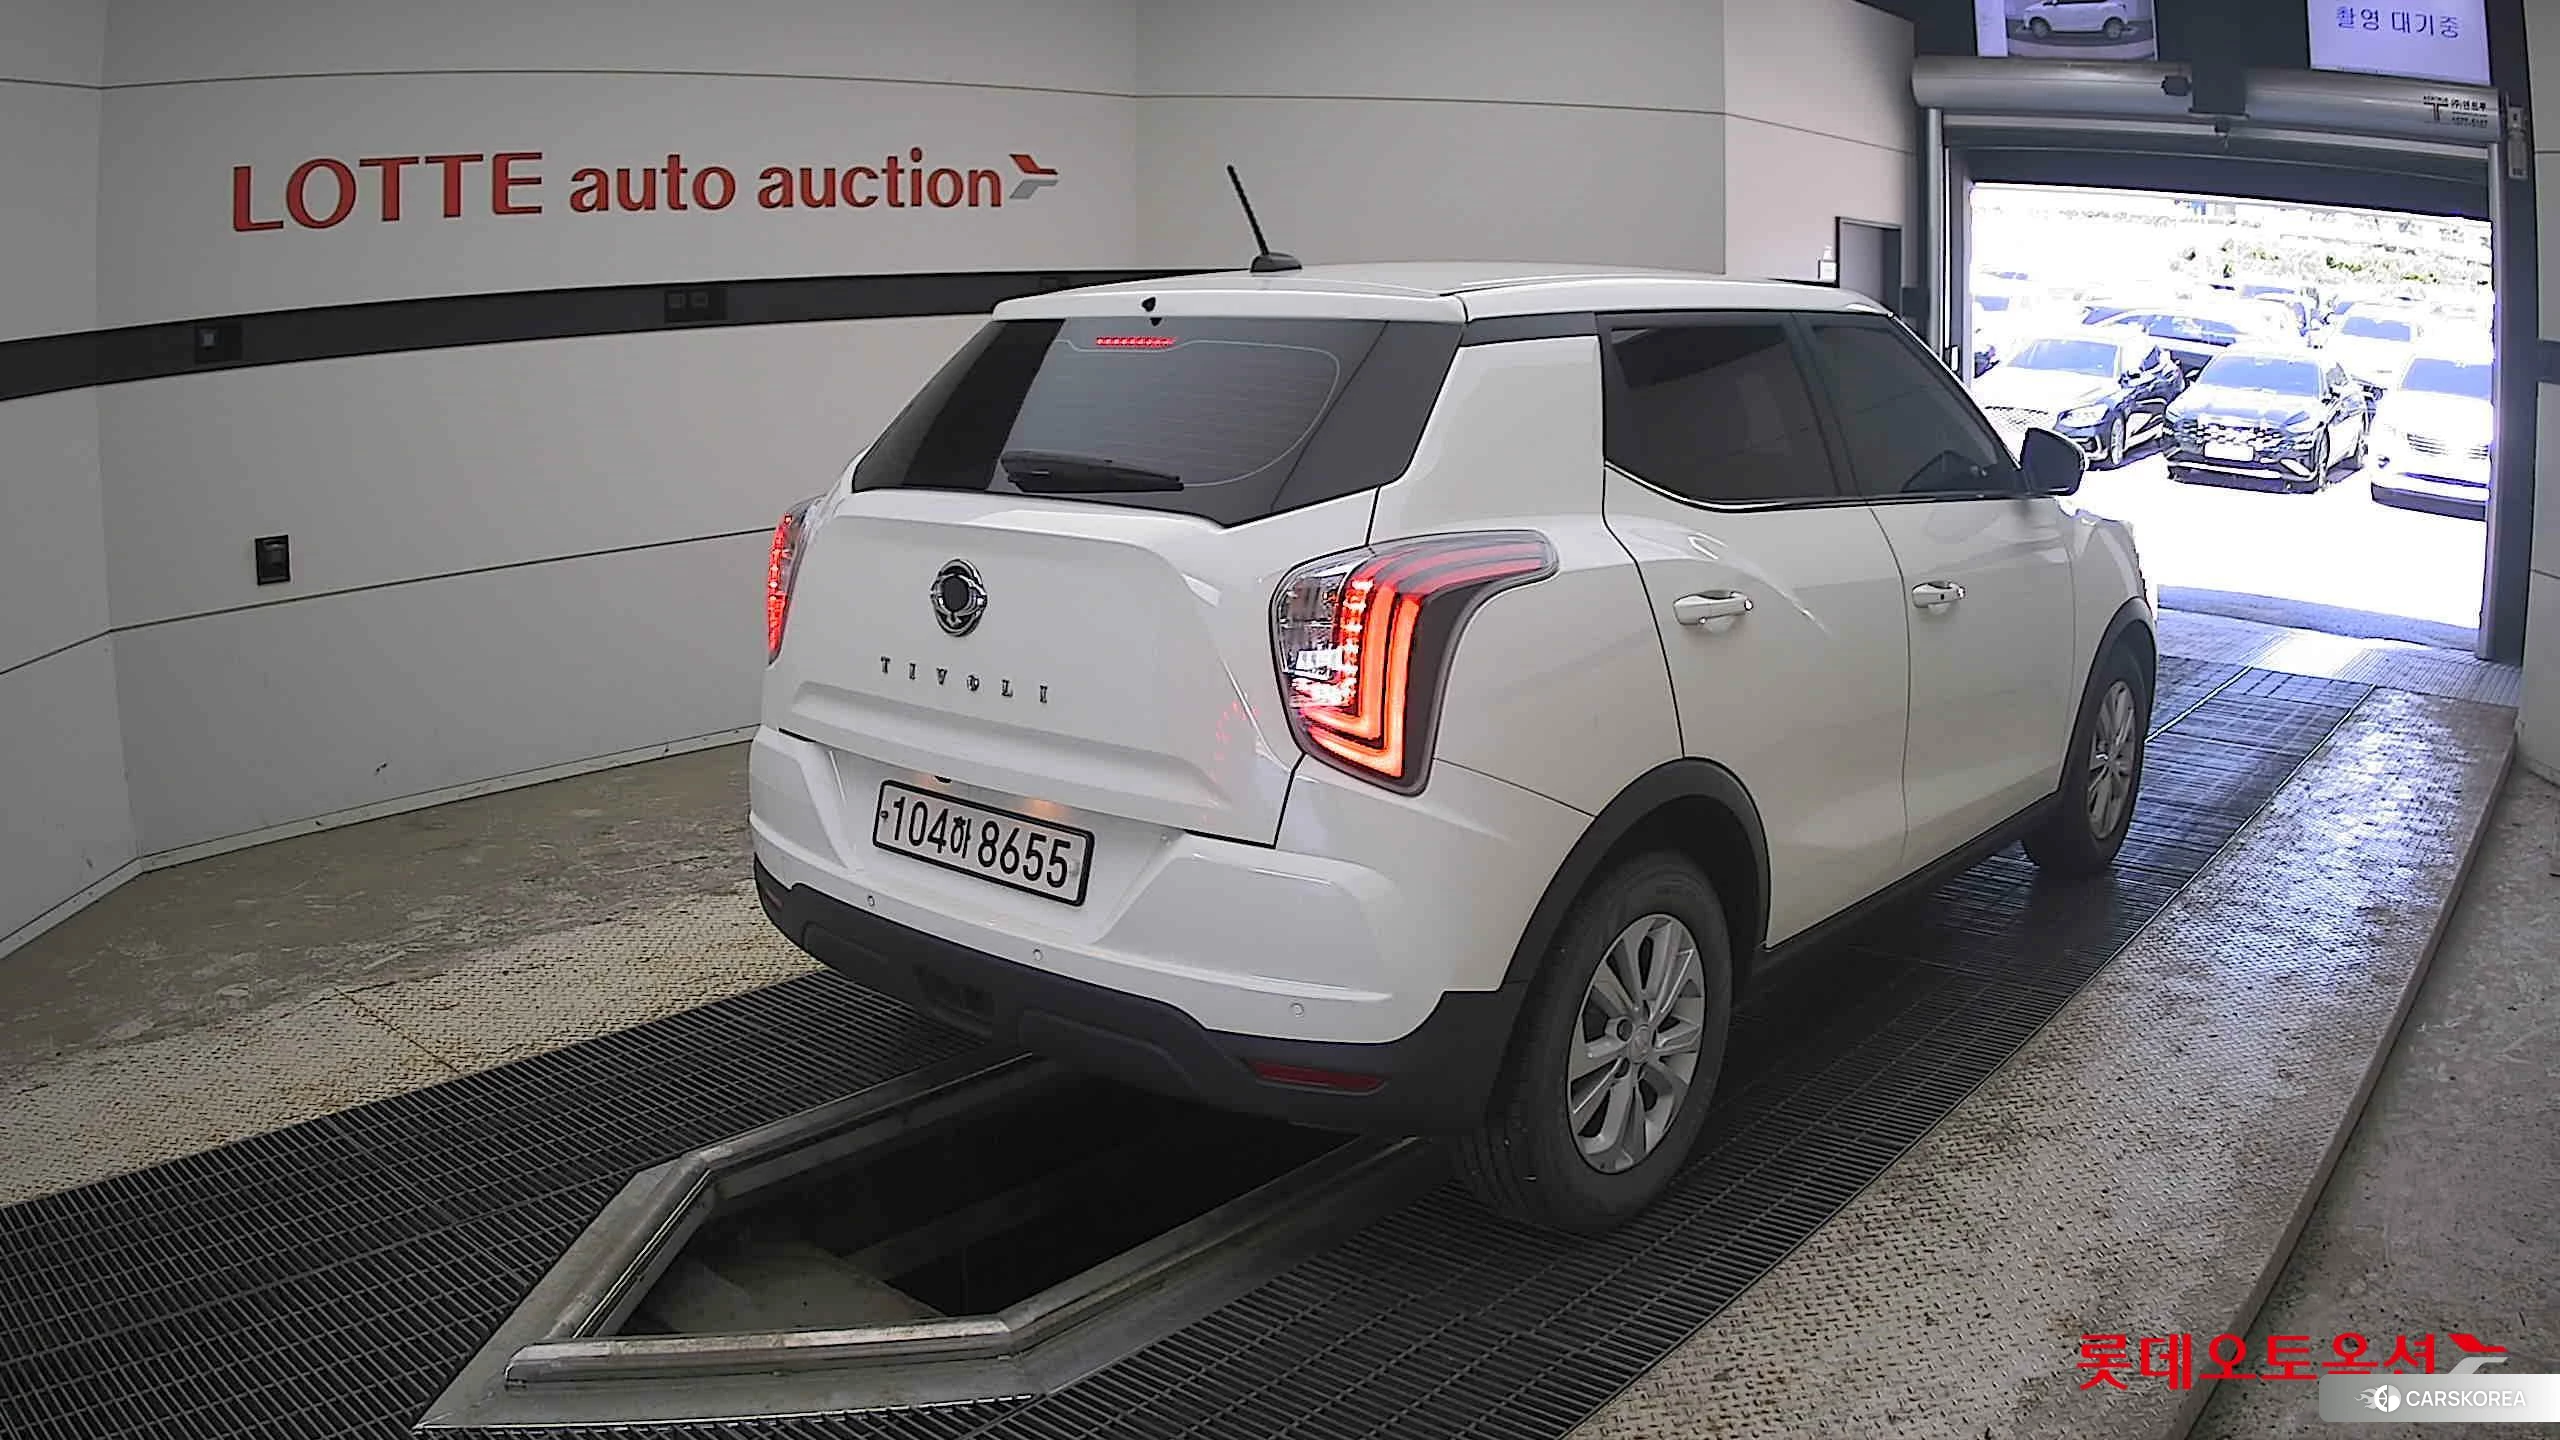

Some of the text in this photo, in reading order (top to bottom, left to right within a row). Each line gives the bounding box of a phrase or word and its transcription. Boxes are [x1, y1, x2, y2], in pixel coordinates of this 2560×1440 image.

[2337, 6, 2459, 39] 촬영 대기중
[232, 147, 1003, 233] LOTTE auto auction
[880, 655, 1049, 704] TIVOLI
